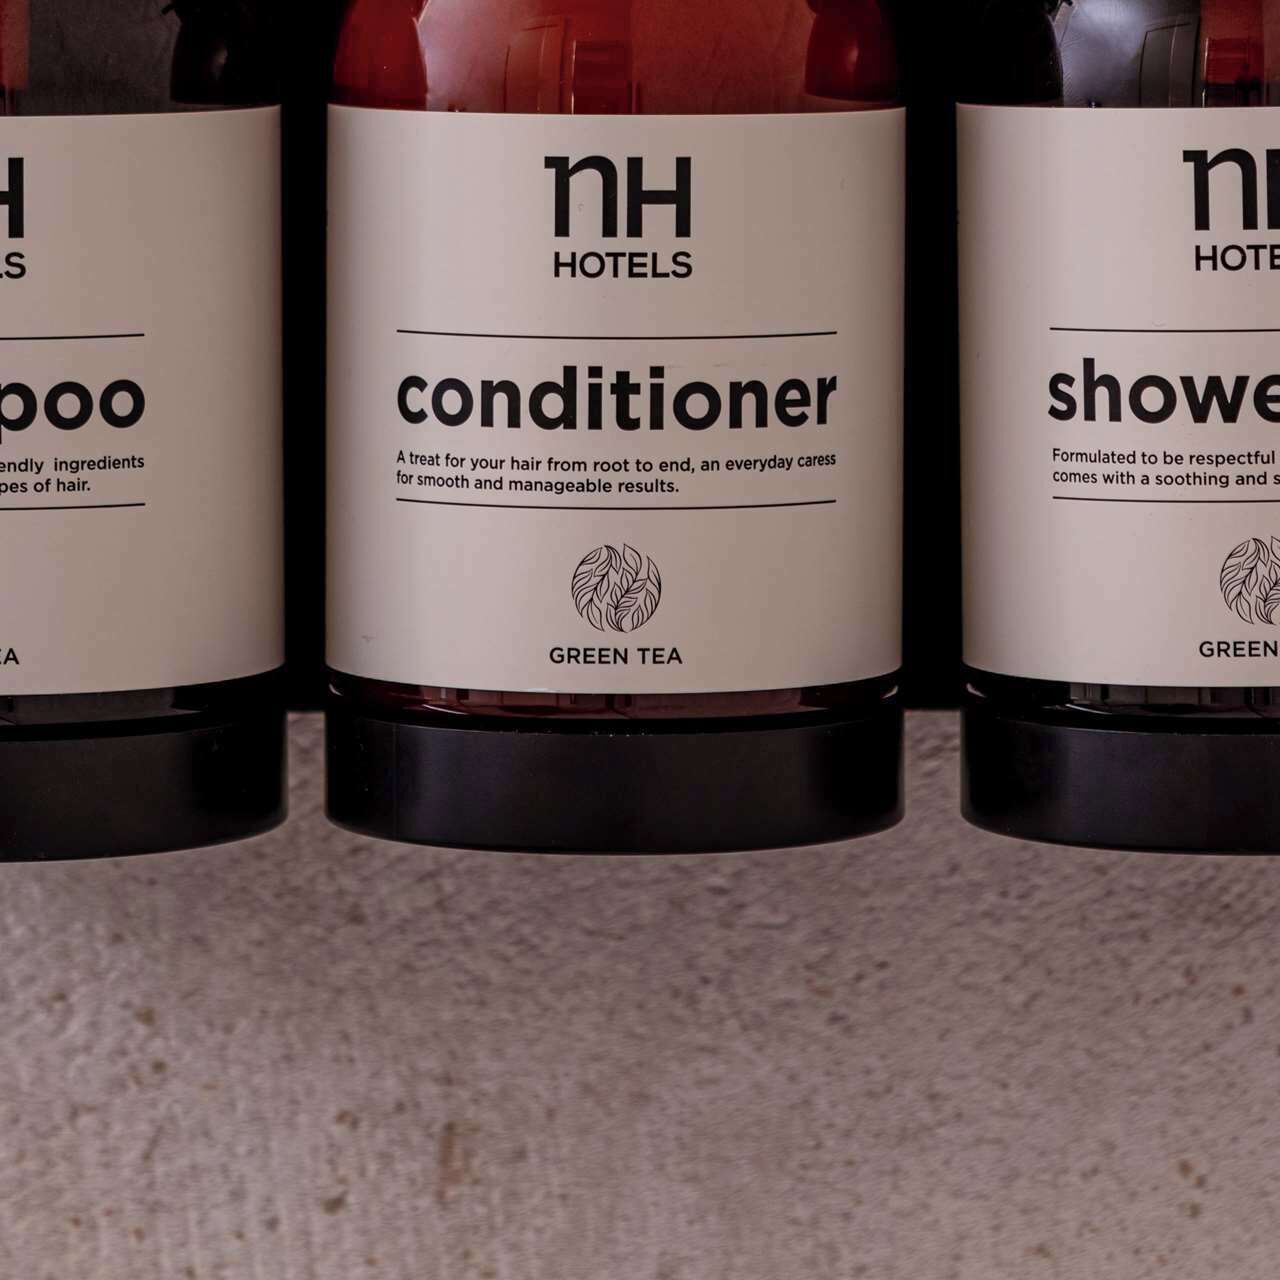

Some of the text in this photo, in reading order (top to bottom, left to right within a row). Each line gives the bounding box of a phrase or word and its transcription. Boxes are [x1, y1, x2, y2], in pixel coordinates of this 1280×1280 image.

[553, 250, 694, 279] HOTELS
[396, 364, 838, 432] conditioner
[53, 454, 145, 475] ingredients
[396, 449, 837, 475] A treat for your hair from root to end, an everyday caress
[1052, 447, 1137, 465] Formulated
[1140, 451, 1159, 466] to
[1162, 450, 1185, 466] be
[1188, 449, 1276, 469] respectful
[32, 477, 52, 494] of
[56, 476, 91, 493] hair.
[396, 469, 680, 496] for smooth and manageable results.
[1052, 470, 1098, 484] comes
[1101, 470, 1136, 486] with
[1140, 474, 1151, 486] a
[1154, 471, 1230, 489] soothing
[1234, 470, 1268, 486] and
[548, 646, 684, 665] GREEN TEA
[1198, 639, 1279, 658] GREEN
